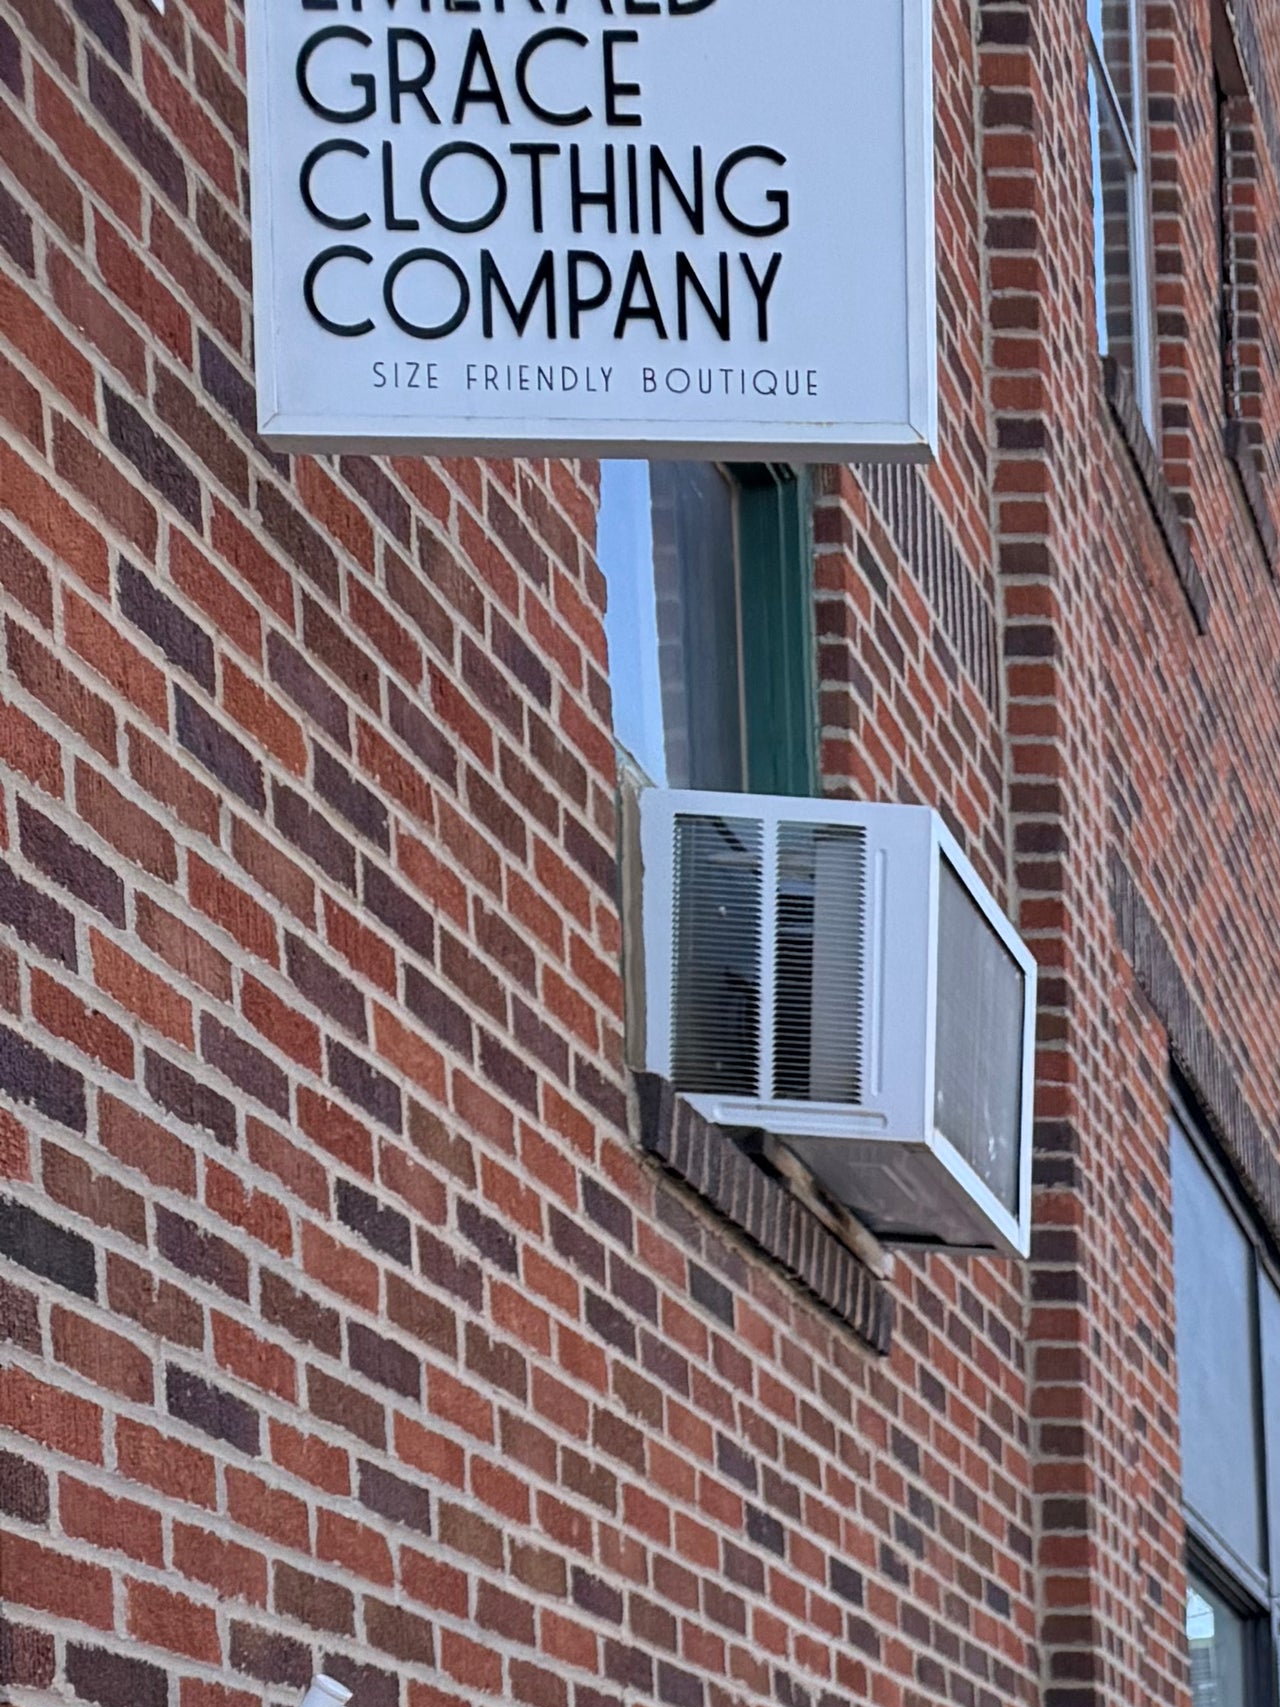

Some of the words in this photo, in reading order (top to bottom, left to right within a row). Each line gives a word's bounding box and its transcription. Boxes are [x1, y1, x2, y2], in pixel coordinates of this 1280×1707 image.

[295, 25, 643, 126] GRACE
[299, 138, 790, 237] CLOTHING
[302, 244, 783, 343] COMPANY
[372, 361, 439, 390] SIZE
[466, 364, 613, 393] FRIENDLY
[643, 367, 818, 396] BOUTIQUE
